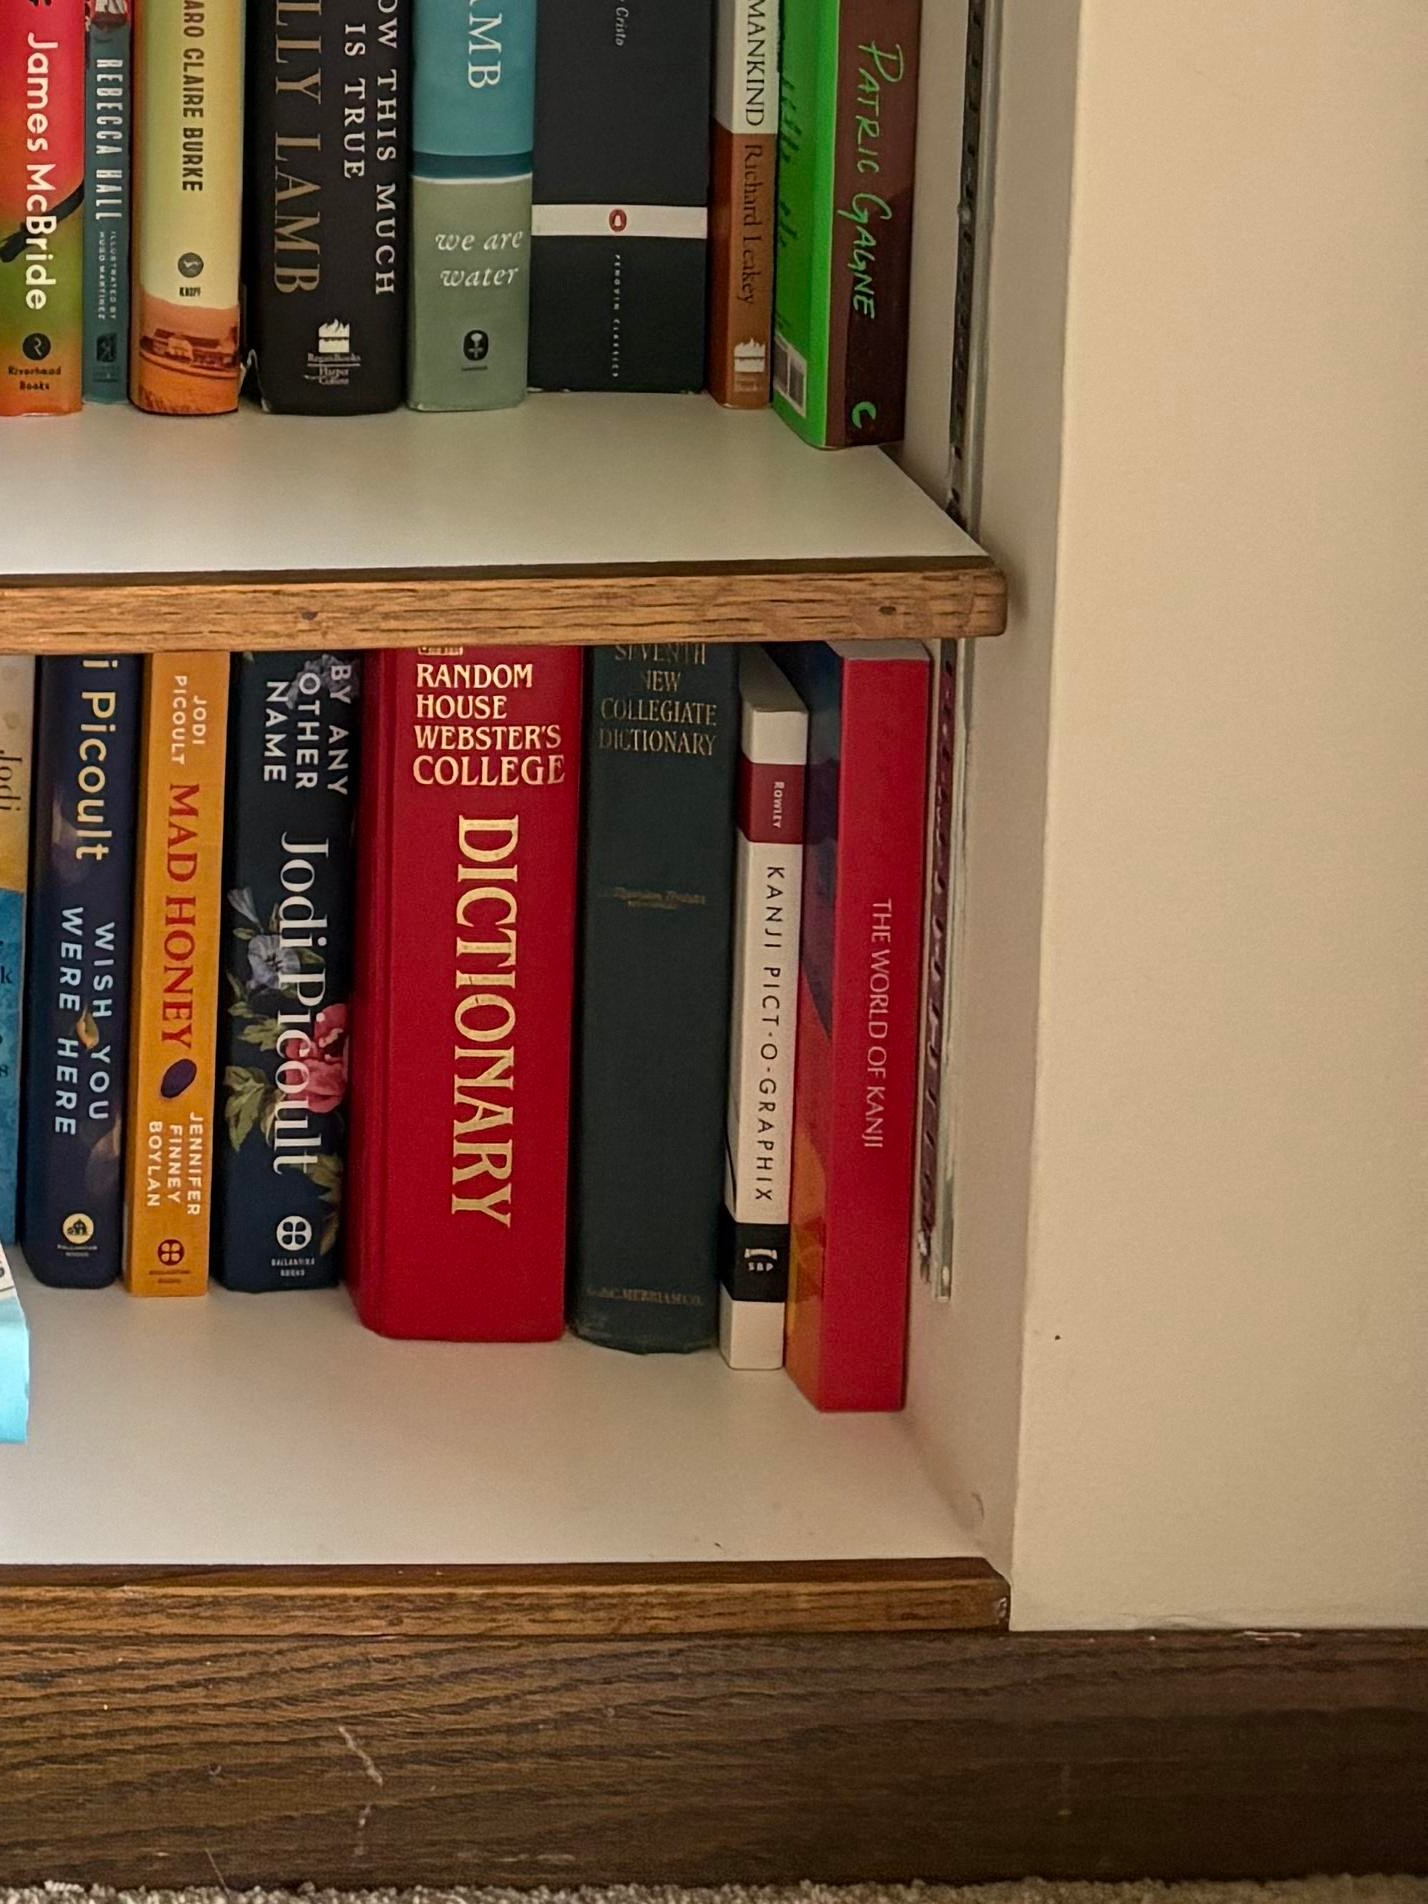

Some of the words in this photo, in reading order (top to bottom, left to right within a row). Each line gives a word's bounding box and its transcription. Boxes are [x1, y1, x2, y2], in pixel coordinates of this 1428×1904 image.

[435, 228, 469, 252] we
[476, 228, 525, 252] are
[440, 262, 520, 289] water
[415, 663, 533, 688] RANDOM
[415, 695, 507, 720] HOUSE
[414, 724, 562, 751] WEBSTER'S
[412, 754, 565, 786] COLLEGE
[450, 813, 520, 1228] DICTIONARY
